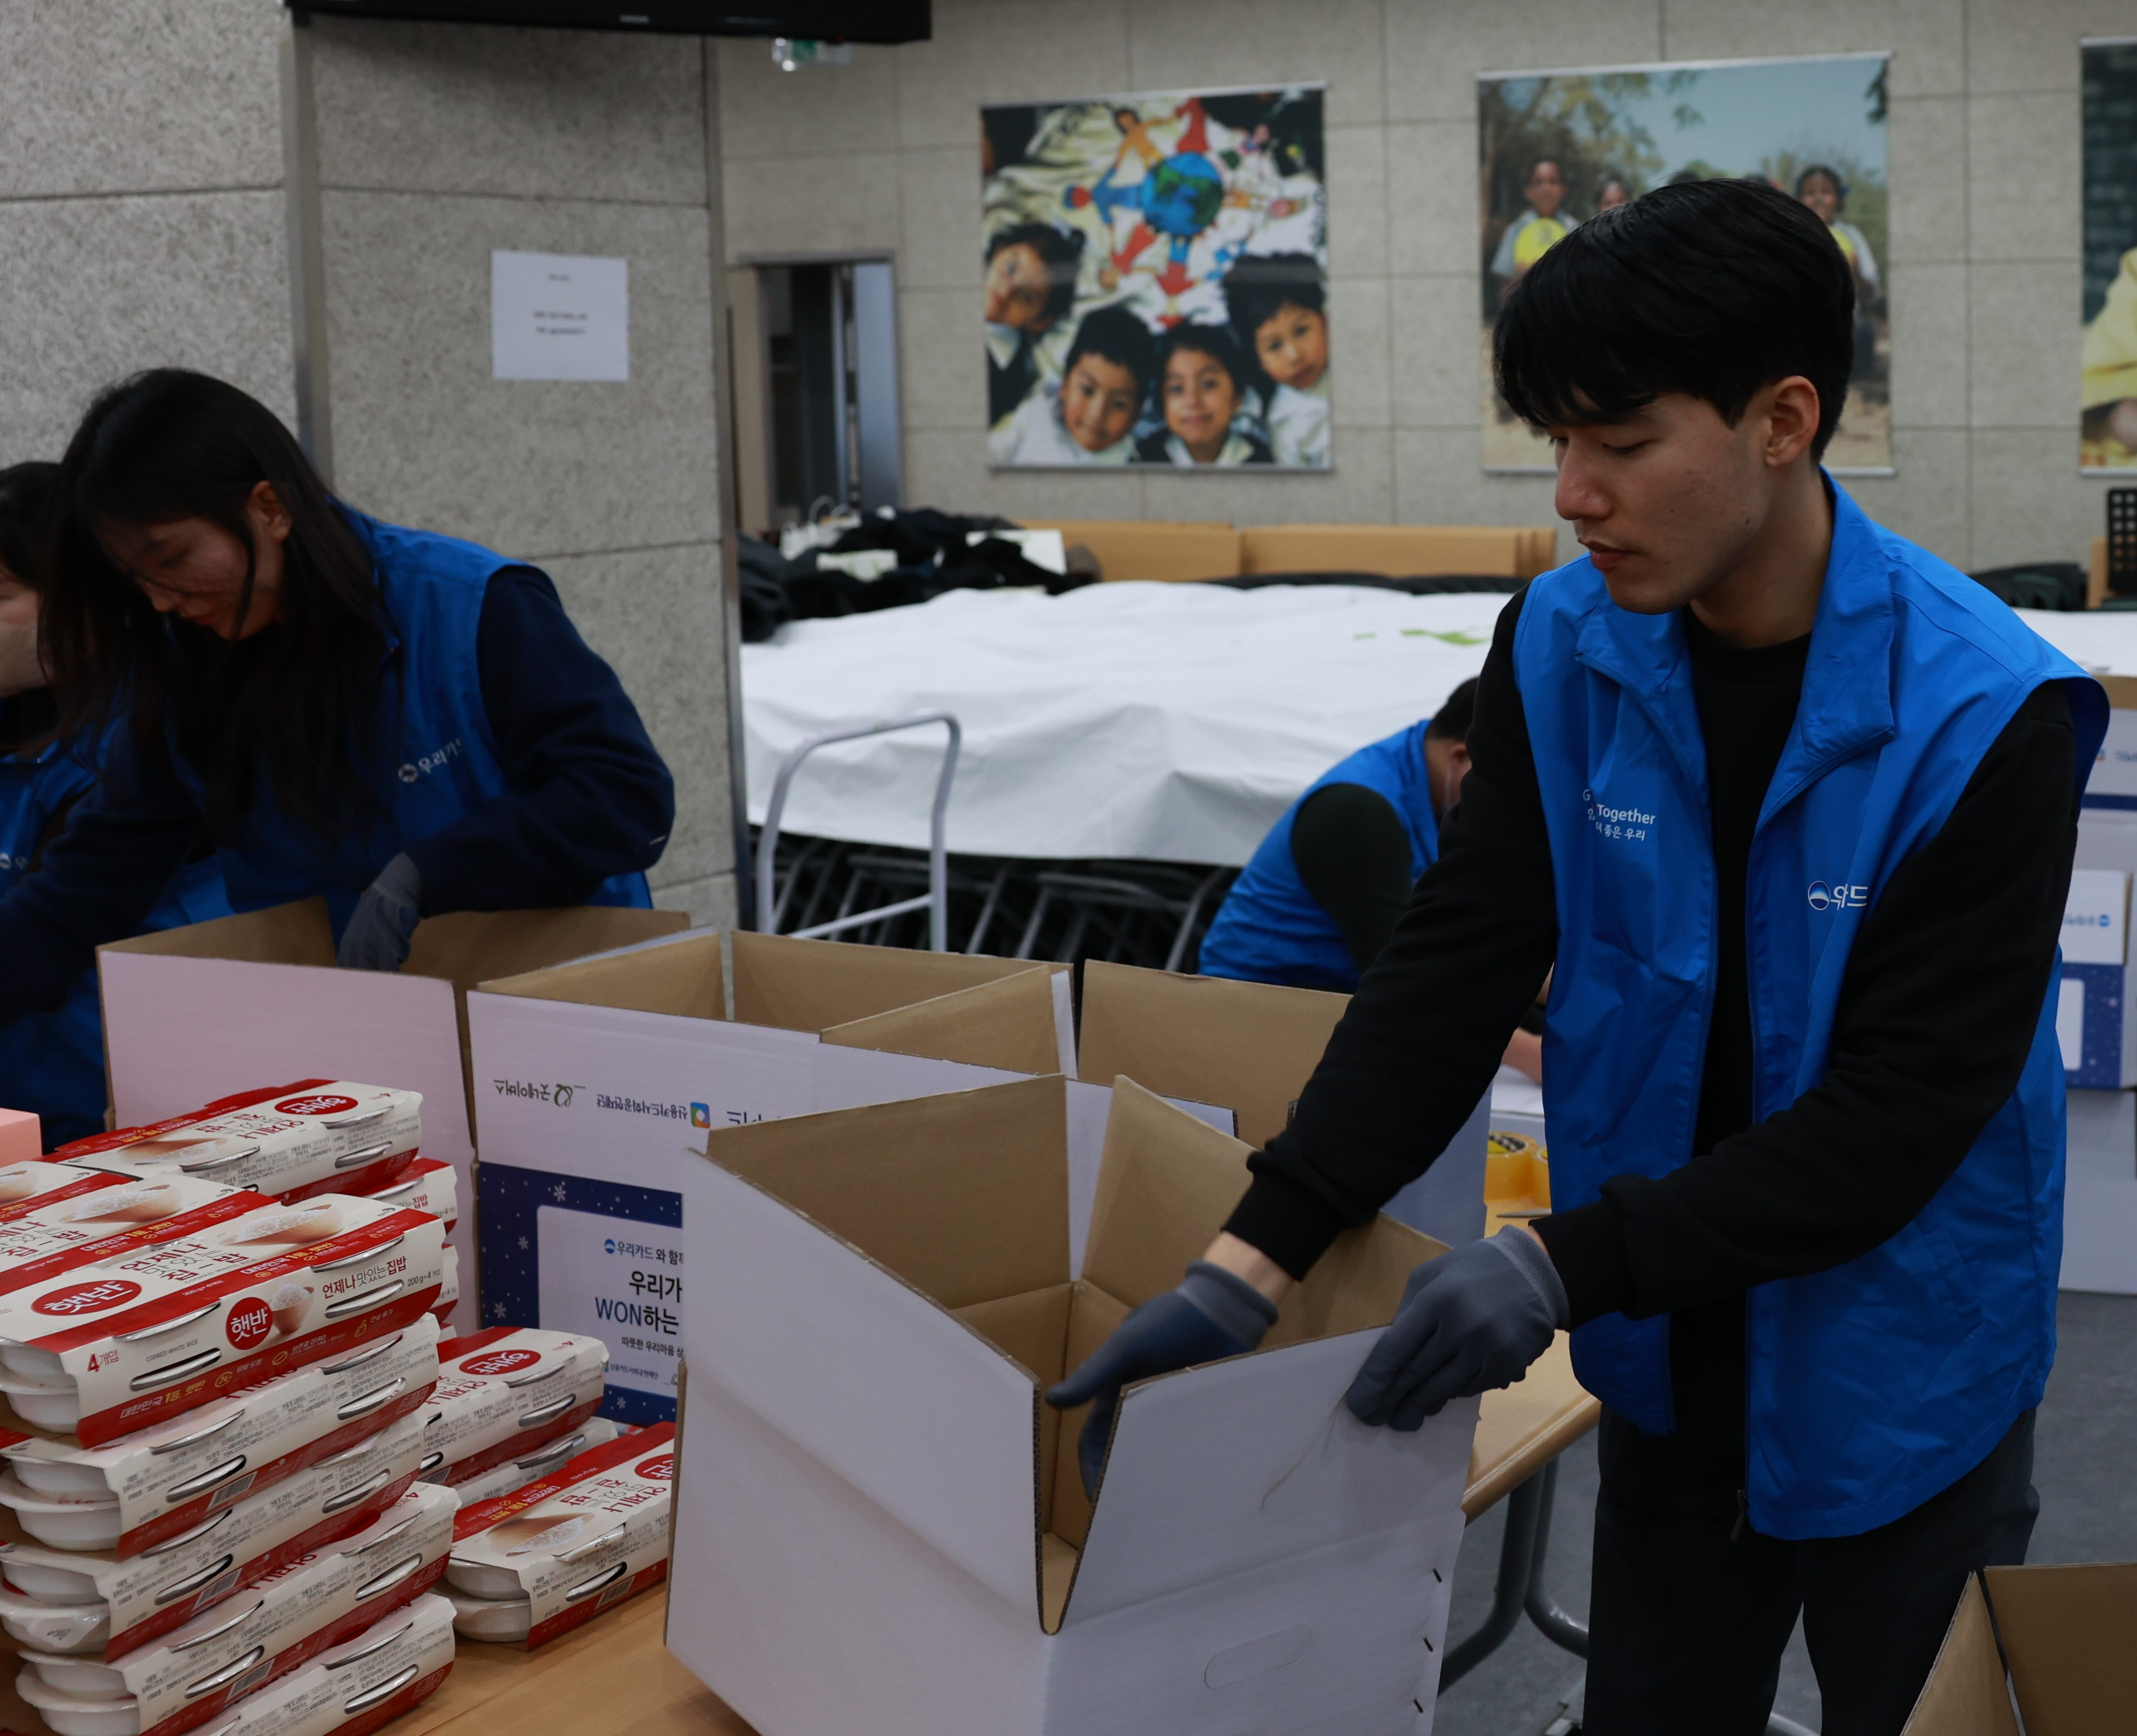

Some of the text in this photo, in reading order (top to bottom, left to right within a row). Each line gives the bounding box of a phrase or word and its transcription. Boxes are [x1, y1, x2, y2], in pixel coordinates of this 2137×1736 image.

[1596, 804, 1656, 825] Together
[1604, 824, 1622, 839] 좋은
[1624, 827, 1646, 841] 우리
[494, 1079, 550, 1101] 굿네이버스
[283, 1096, 347, 1115] 햇반
[596, 1094, 687, 1120] 신용카드사회공헌재단
[412, 1194, 428, 1209] 집밥
[119, 1243, 208, 1271] 언제나
[617, 1241, 653, 1260] 우리카드
[655, 1248, 666, 1264] 와
[240, 1257, 291, 1274] 대한민국
[43, 1280, 134, 1314] 햇반
[629, 1270, 682, 1303] 우리가
[230, 1307, 269, 1343] 햇반
[595, 1297, 679, 1335] WON하는
[145, 1338, 199, 1363] COOKED WHITE RICE
[621, 1336, 684, 1358] 따뜻한 우리마음 상
[87, 1349, 119, 1373] 4개입
[467, 1351, 532, 1375] 햇반
[119, 1396, 163, 1419] 대한민국
[184, 1378, 206, 1397] 햇반
[425, 1380, 488, 1405] 언제나
[643, 1458, 674, 1479] 반
[602, 1486, 667, 1513] 언제나
